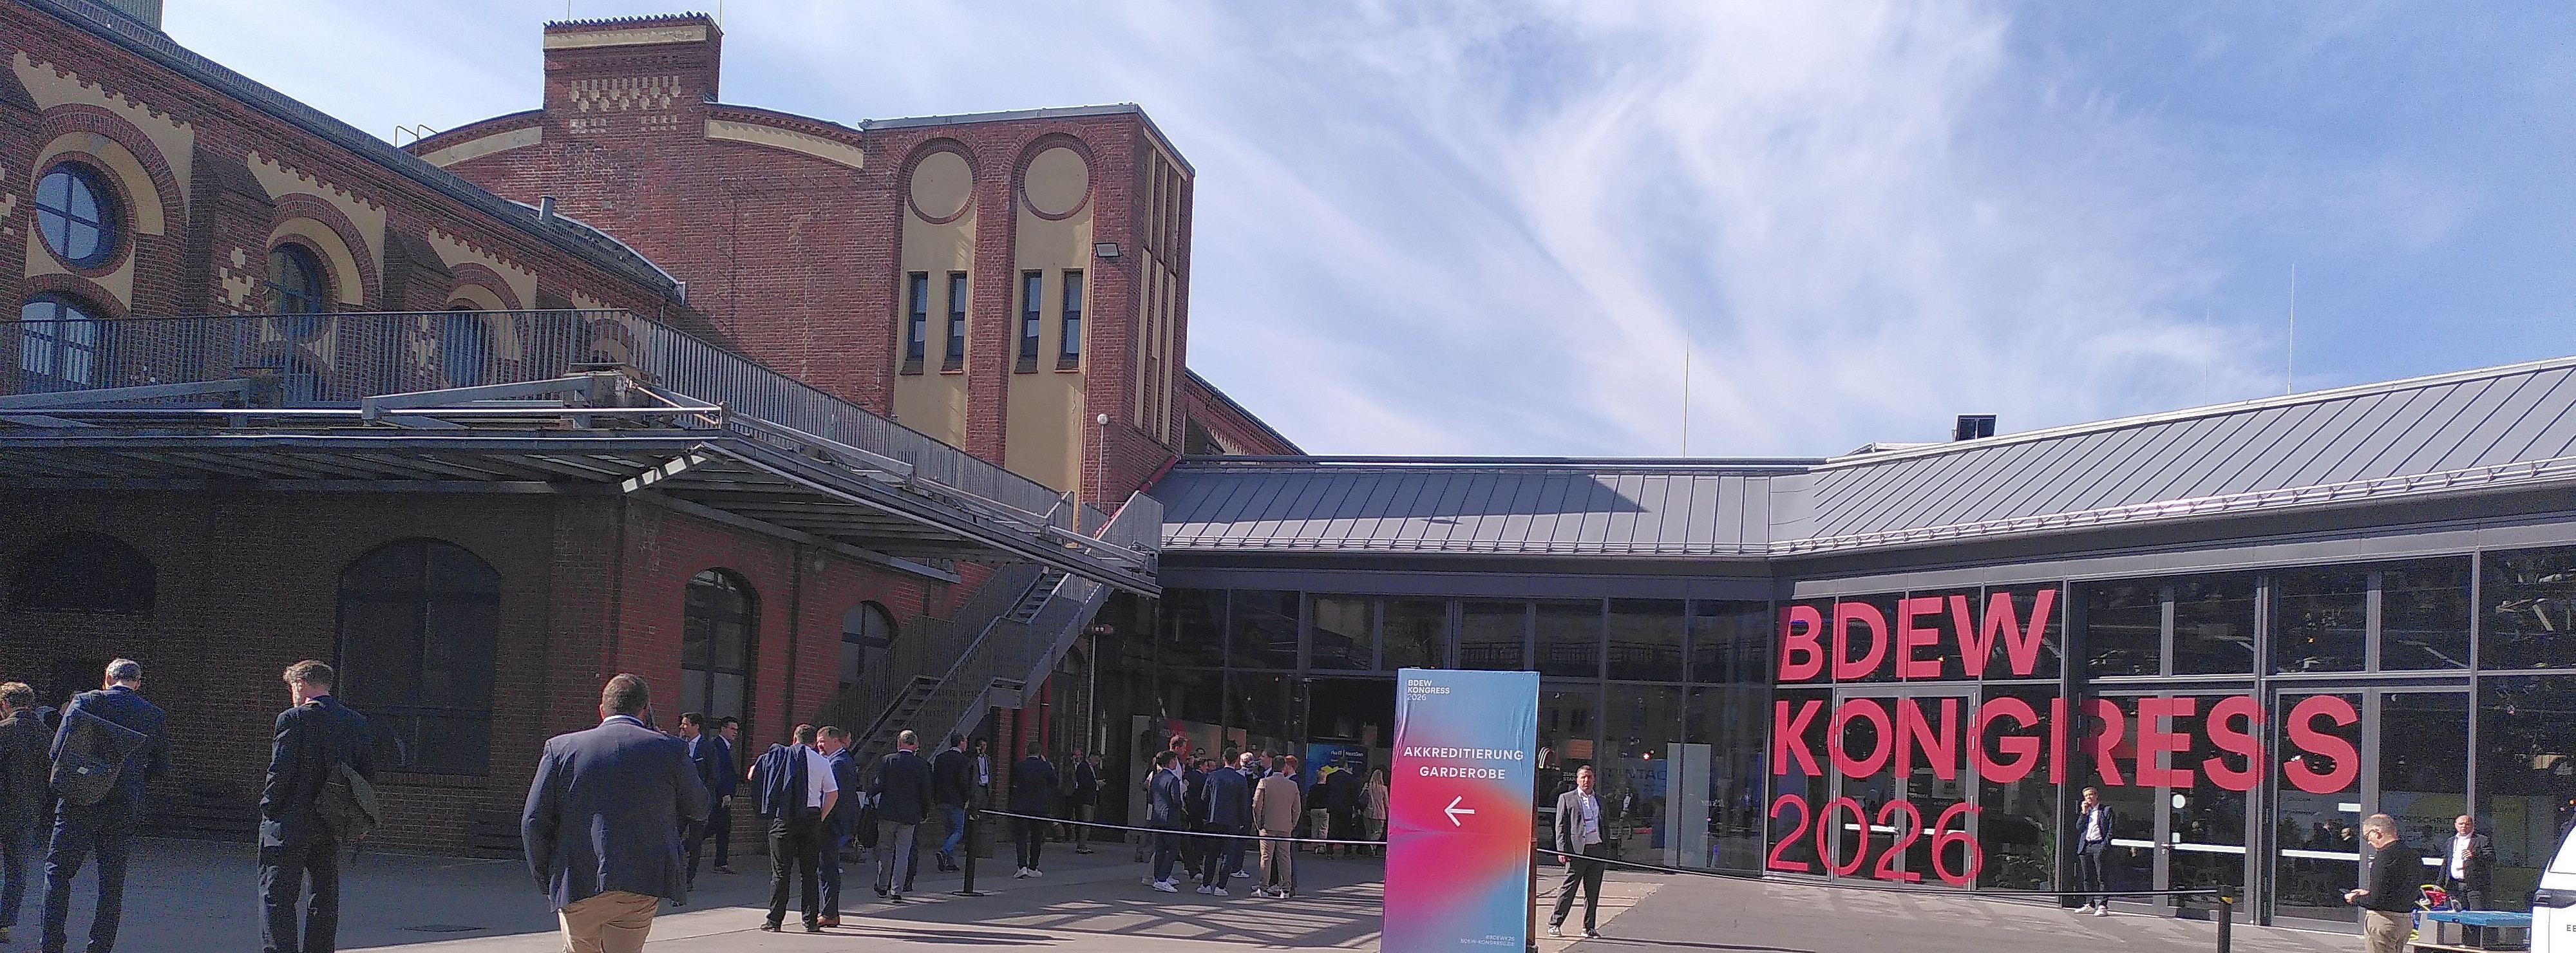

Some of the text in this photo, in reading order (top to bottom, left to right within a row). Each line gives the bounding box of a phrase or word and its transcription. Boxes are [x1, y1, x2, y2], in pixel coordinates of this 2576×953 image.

[1777, 590, 2055, 681] BDEW
[1403, 746, 1524, 760] AKKREDITIERUNG
[1419, 766, 1506, 779] GARDEROBE
[1774, 696, 2359, 794] KONGRESS
[1768, 794, 1984, 885] 2026
